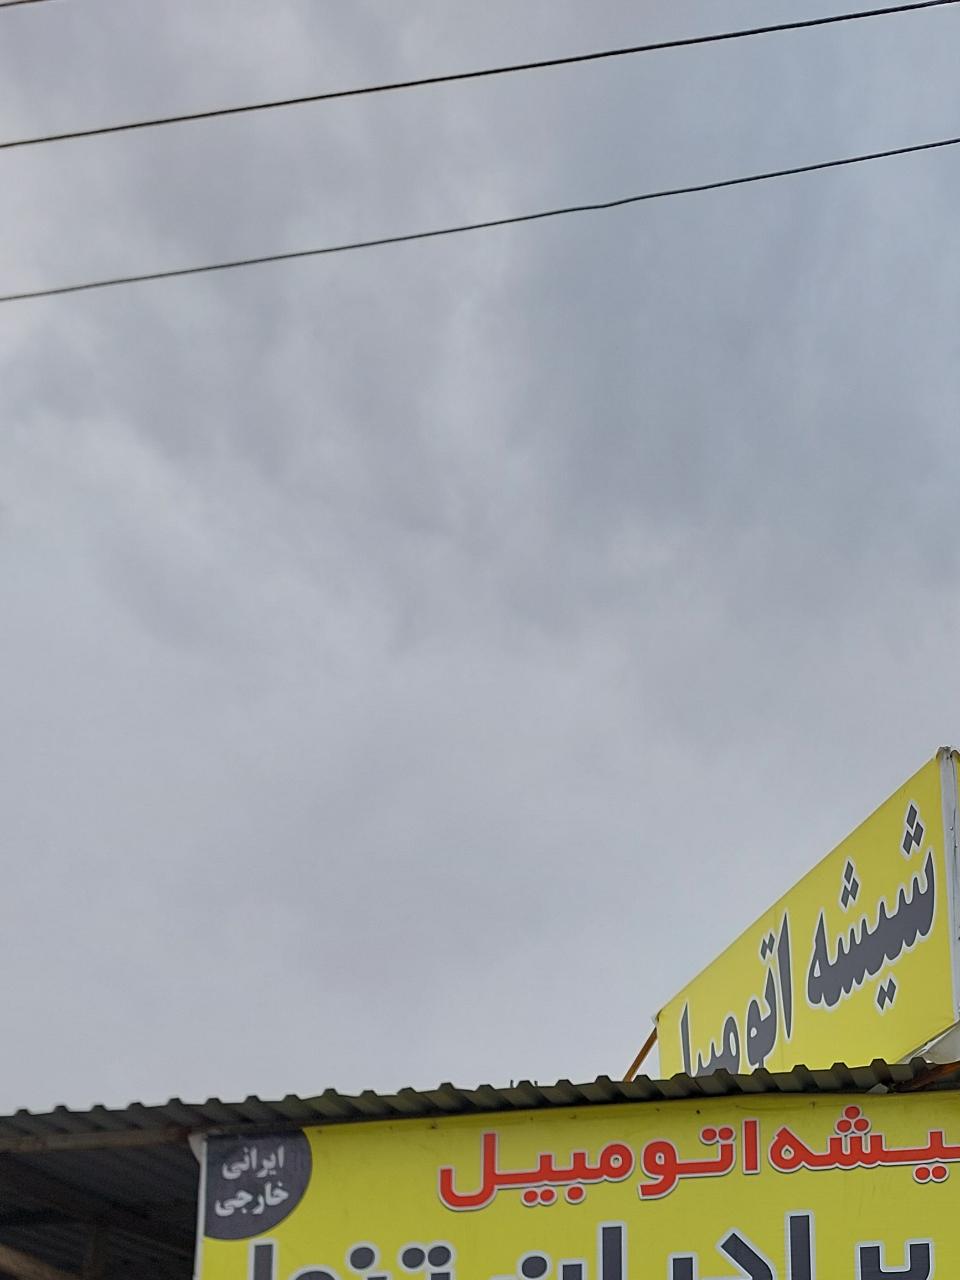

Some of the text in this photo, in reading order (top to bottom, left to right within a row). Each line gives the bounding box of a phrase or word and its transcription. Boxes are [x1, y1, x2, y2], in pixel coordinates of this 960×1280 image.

[806, 803, 936, 1011] شیشه
[221, 1145, 286, 1181] ایرانی
[439, 1119, 759, 1212] اتومبیل
[214, 1181, 290, 1217] خارجی
